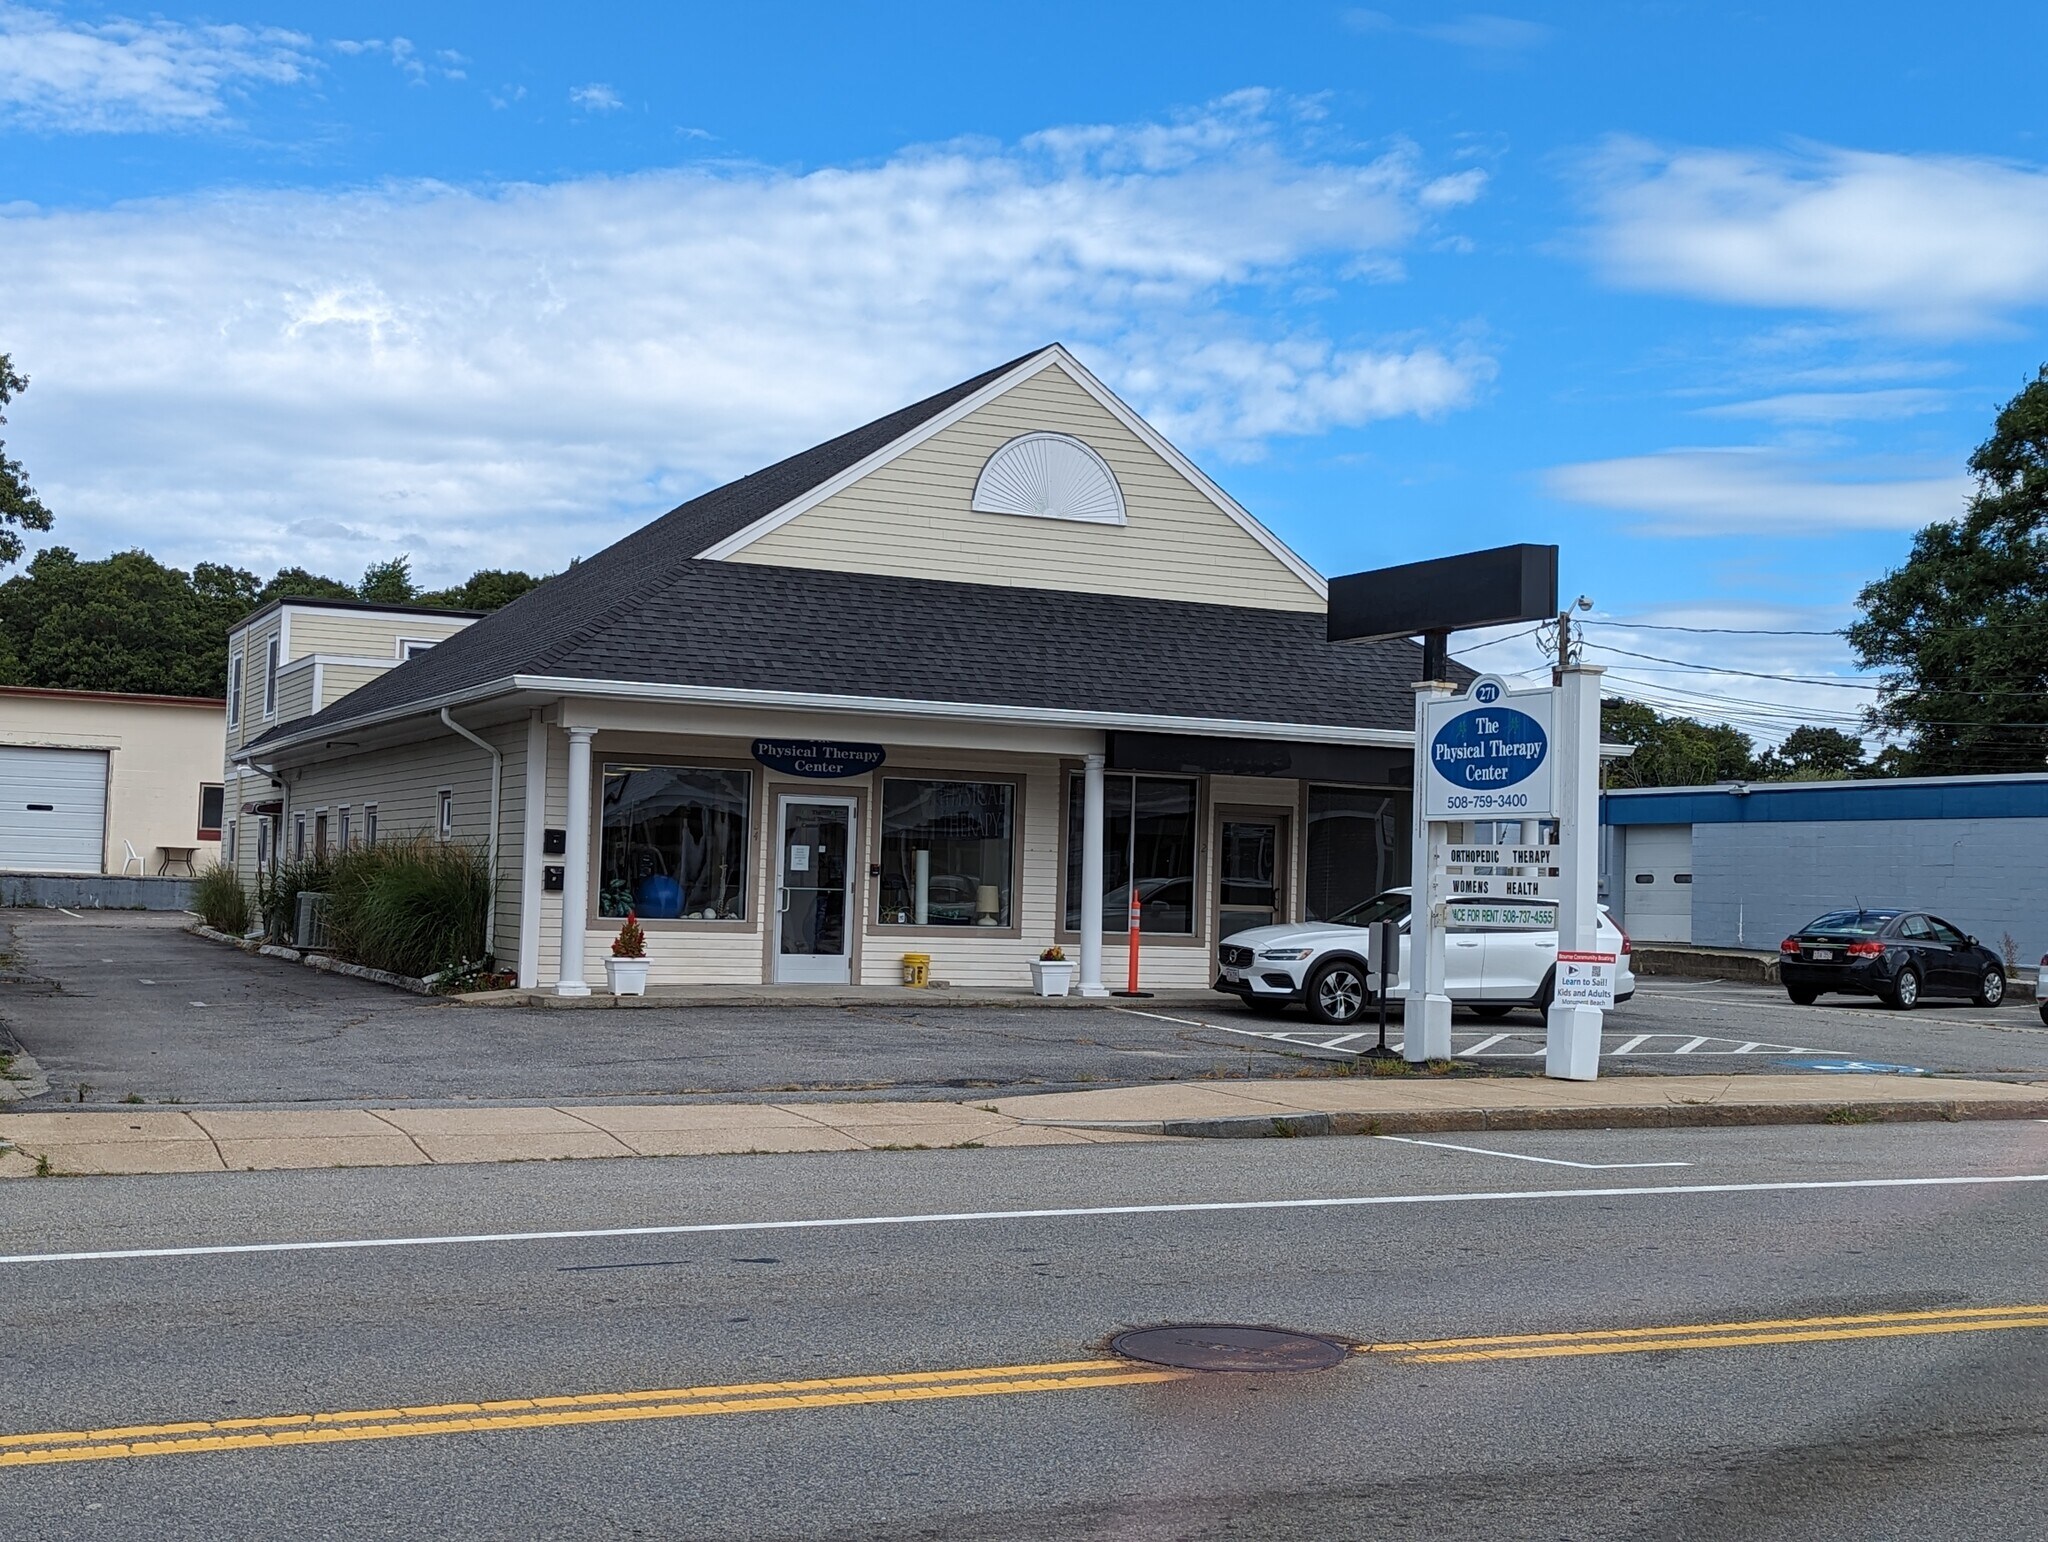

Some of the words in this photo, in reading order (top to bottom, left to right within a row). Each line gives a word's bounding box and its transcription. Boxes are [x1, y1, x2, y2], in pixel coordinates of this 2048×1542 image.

[1480, 687, 1496, 700] 271
[1476, 717, 1499, 734] The
[758, 743, 817, 757] Physical
[822, 746, 880, 762] Therapy
[1435, 741, 1485, 763] Physical
[1489, 739, 1542, 760] Therapy
[794, 760, 844, 773] Center
[1465, 764, 1509, 782] Center
[1447, 794, 1528, 809] 508-759-3400
[942, 812, 1002, 837] THERAPY
[1450, 849, 1500, 863] ORTHOPEDIC
[1512, 850, 1551, 864] THERAPY
[1452, 880, 1489, 894] WOMENS
[1506, 882, 1539, 895] HEALTH
[1467, 909, 1480, 922] FOR
[1482, 909, 1500, 923] RENT
[1502, 909, 1553, 924] 508-737-4555
[1562, 977, 1581, 985] Learn
[1582, 978, 1591, 986] to
[1591, 978, 1608, 987] Sail!
[1557, 988, 1572, 997] Kids
[1572, 989, 1587, 997] and
[1588, 989, 1612, 998] Adults
